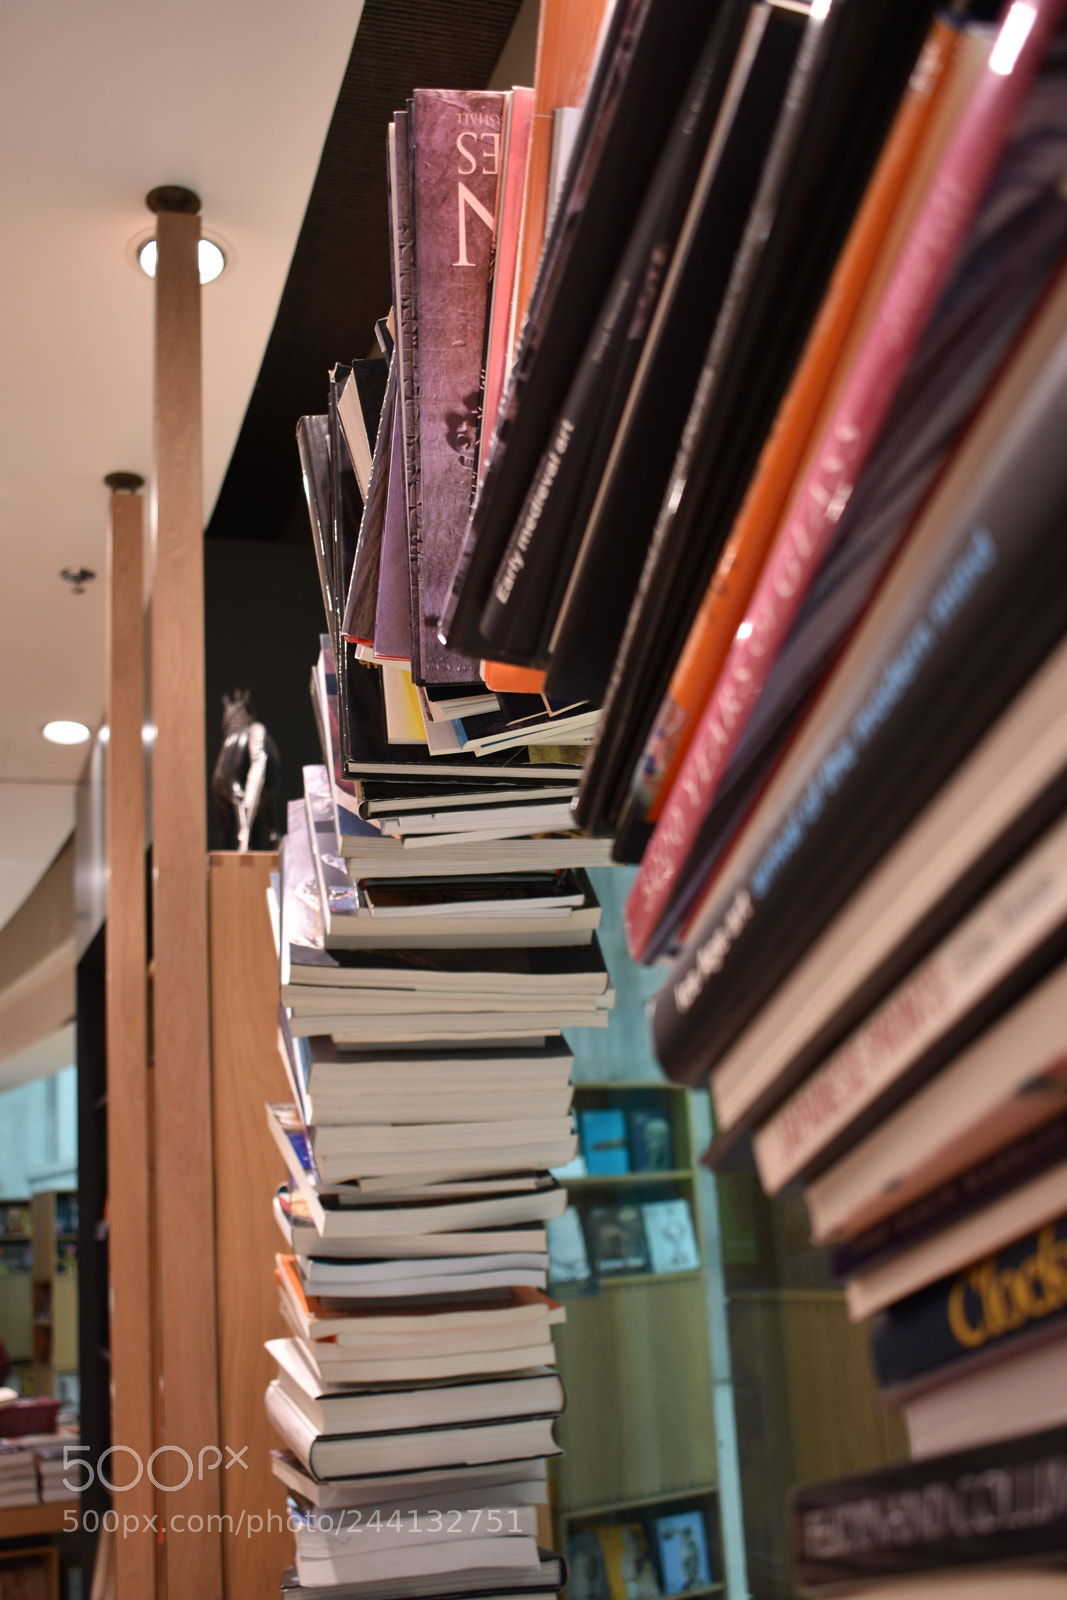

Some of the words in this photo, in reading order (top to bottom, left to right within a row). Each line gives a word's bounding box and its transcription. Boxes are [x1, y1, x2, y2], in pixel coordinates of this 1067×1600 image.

[456, 131, 500, 175] ES
[496, 551, 525, 604] Early
[517, 452, 561, 552] medieval
[554, 419, 576, 454] art
